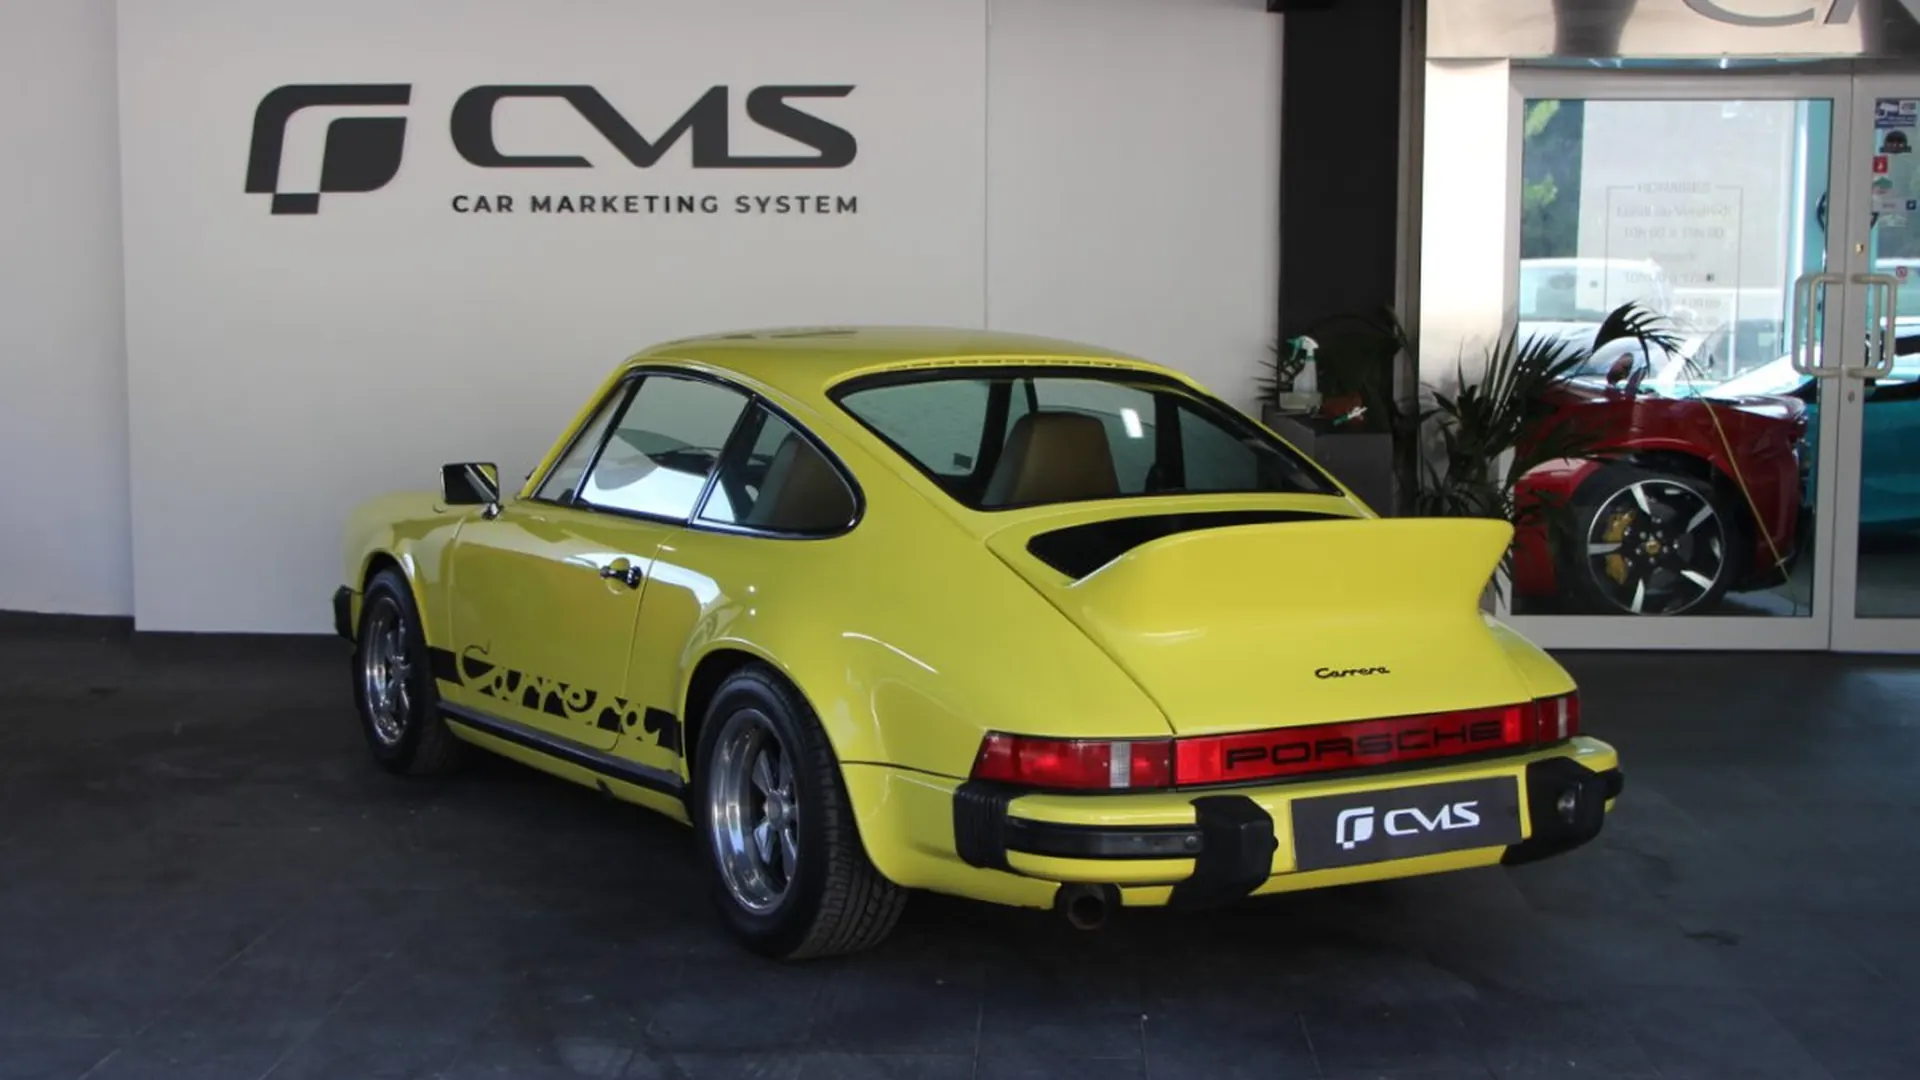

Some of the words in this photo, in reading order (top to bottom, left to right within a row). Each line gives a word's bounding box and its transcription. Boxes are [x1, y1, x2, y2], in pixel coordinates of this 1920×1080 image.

[451, 85, 857, 168] CMS
[452, 195, 513, 213] CAR
[531, 195, 718, 213] MARKETING
[736, 195, 858, 213] SYSTEM
[456, 641, 661, 747] Carrera
[1314, 666, 1391, 680] Carrera
[1226, 720, 1501, 770] PORSCHE
[1384, 801, 1481, 836] CMS
